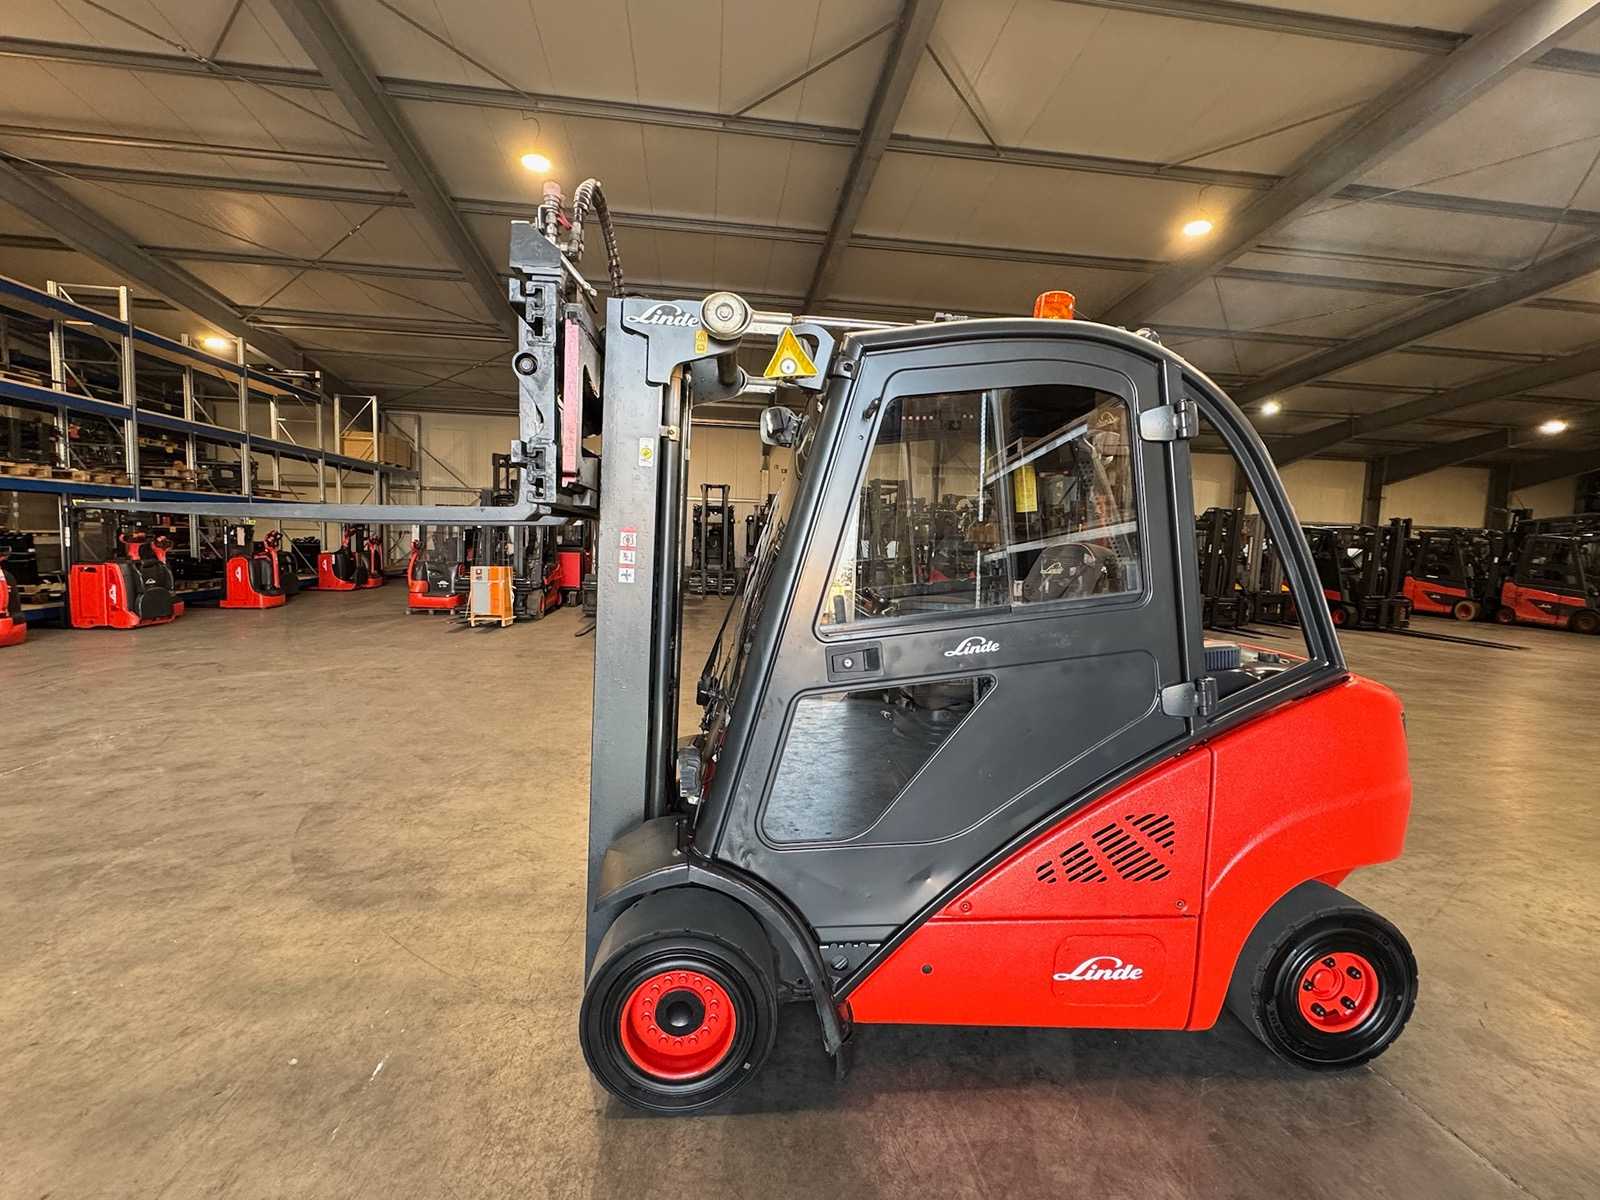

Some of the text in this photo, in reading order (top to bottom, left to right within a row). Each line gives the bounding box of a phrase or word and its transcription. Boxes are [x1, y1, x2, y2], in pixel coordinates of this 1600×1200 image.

[627, 303, 699, 327] Linde
[944, 636, 1000, 656] Linde
[1053, 956, 1143, 981] Linde
